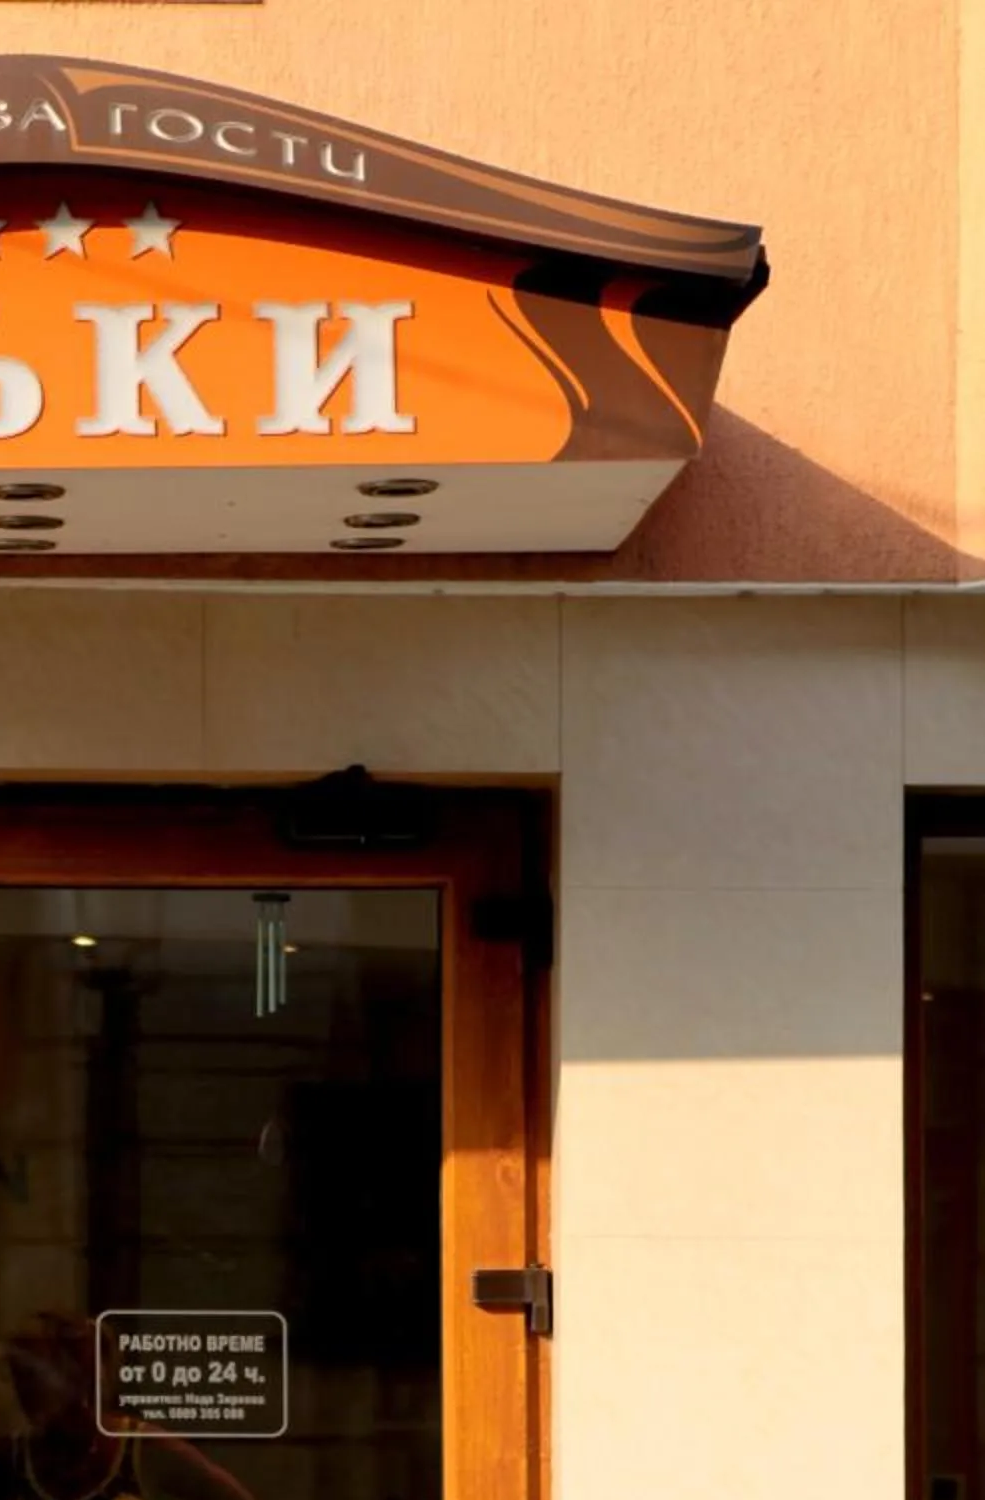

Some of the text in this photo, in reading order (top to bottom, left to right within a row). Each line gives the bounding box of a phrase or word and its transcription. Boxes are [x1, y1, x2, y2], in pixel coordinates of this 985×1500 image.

[109, 102, 367, 182] ГОСТИ
[118, 1333, 265, 1353] РАБОТНО ВРЕМЕ
[118, 1360, 266, 1388] от 0 до 24 ч.
